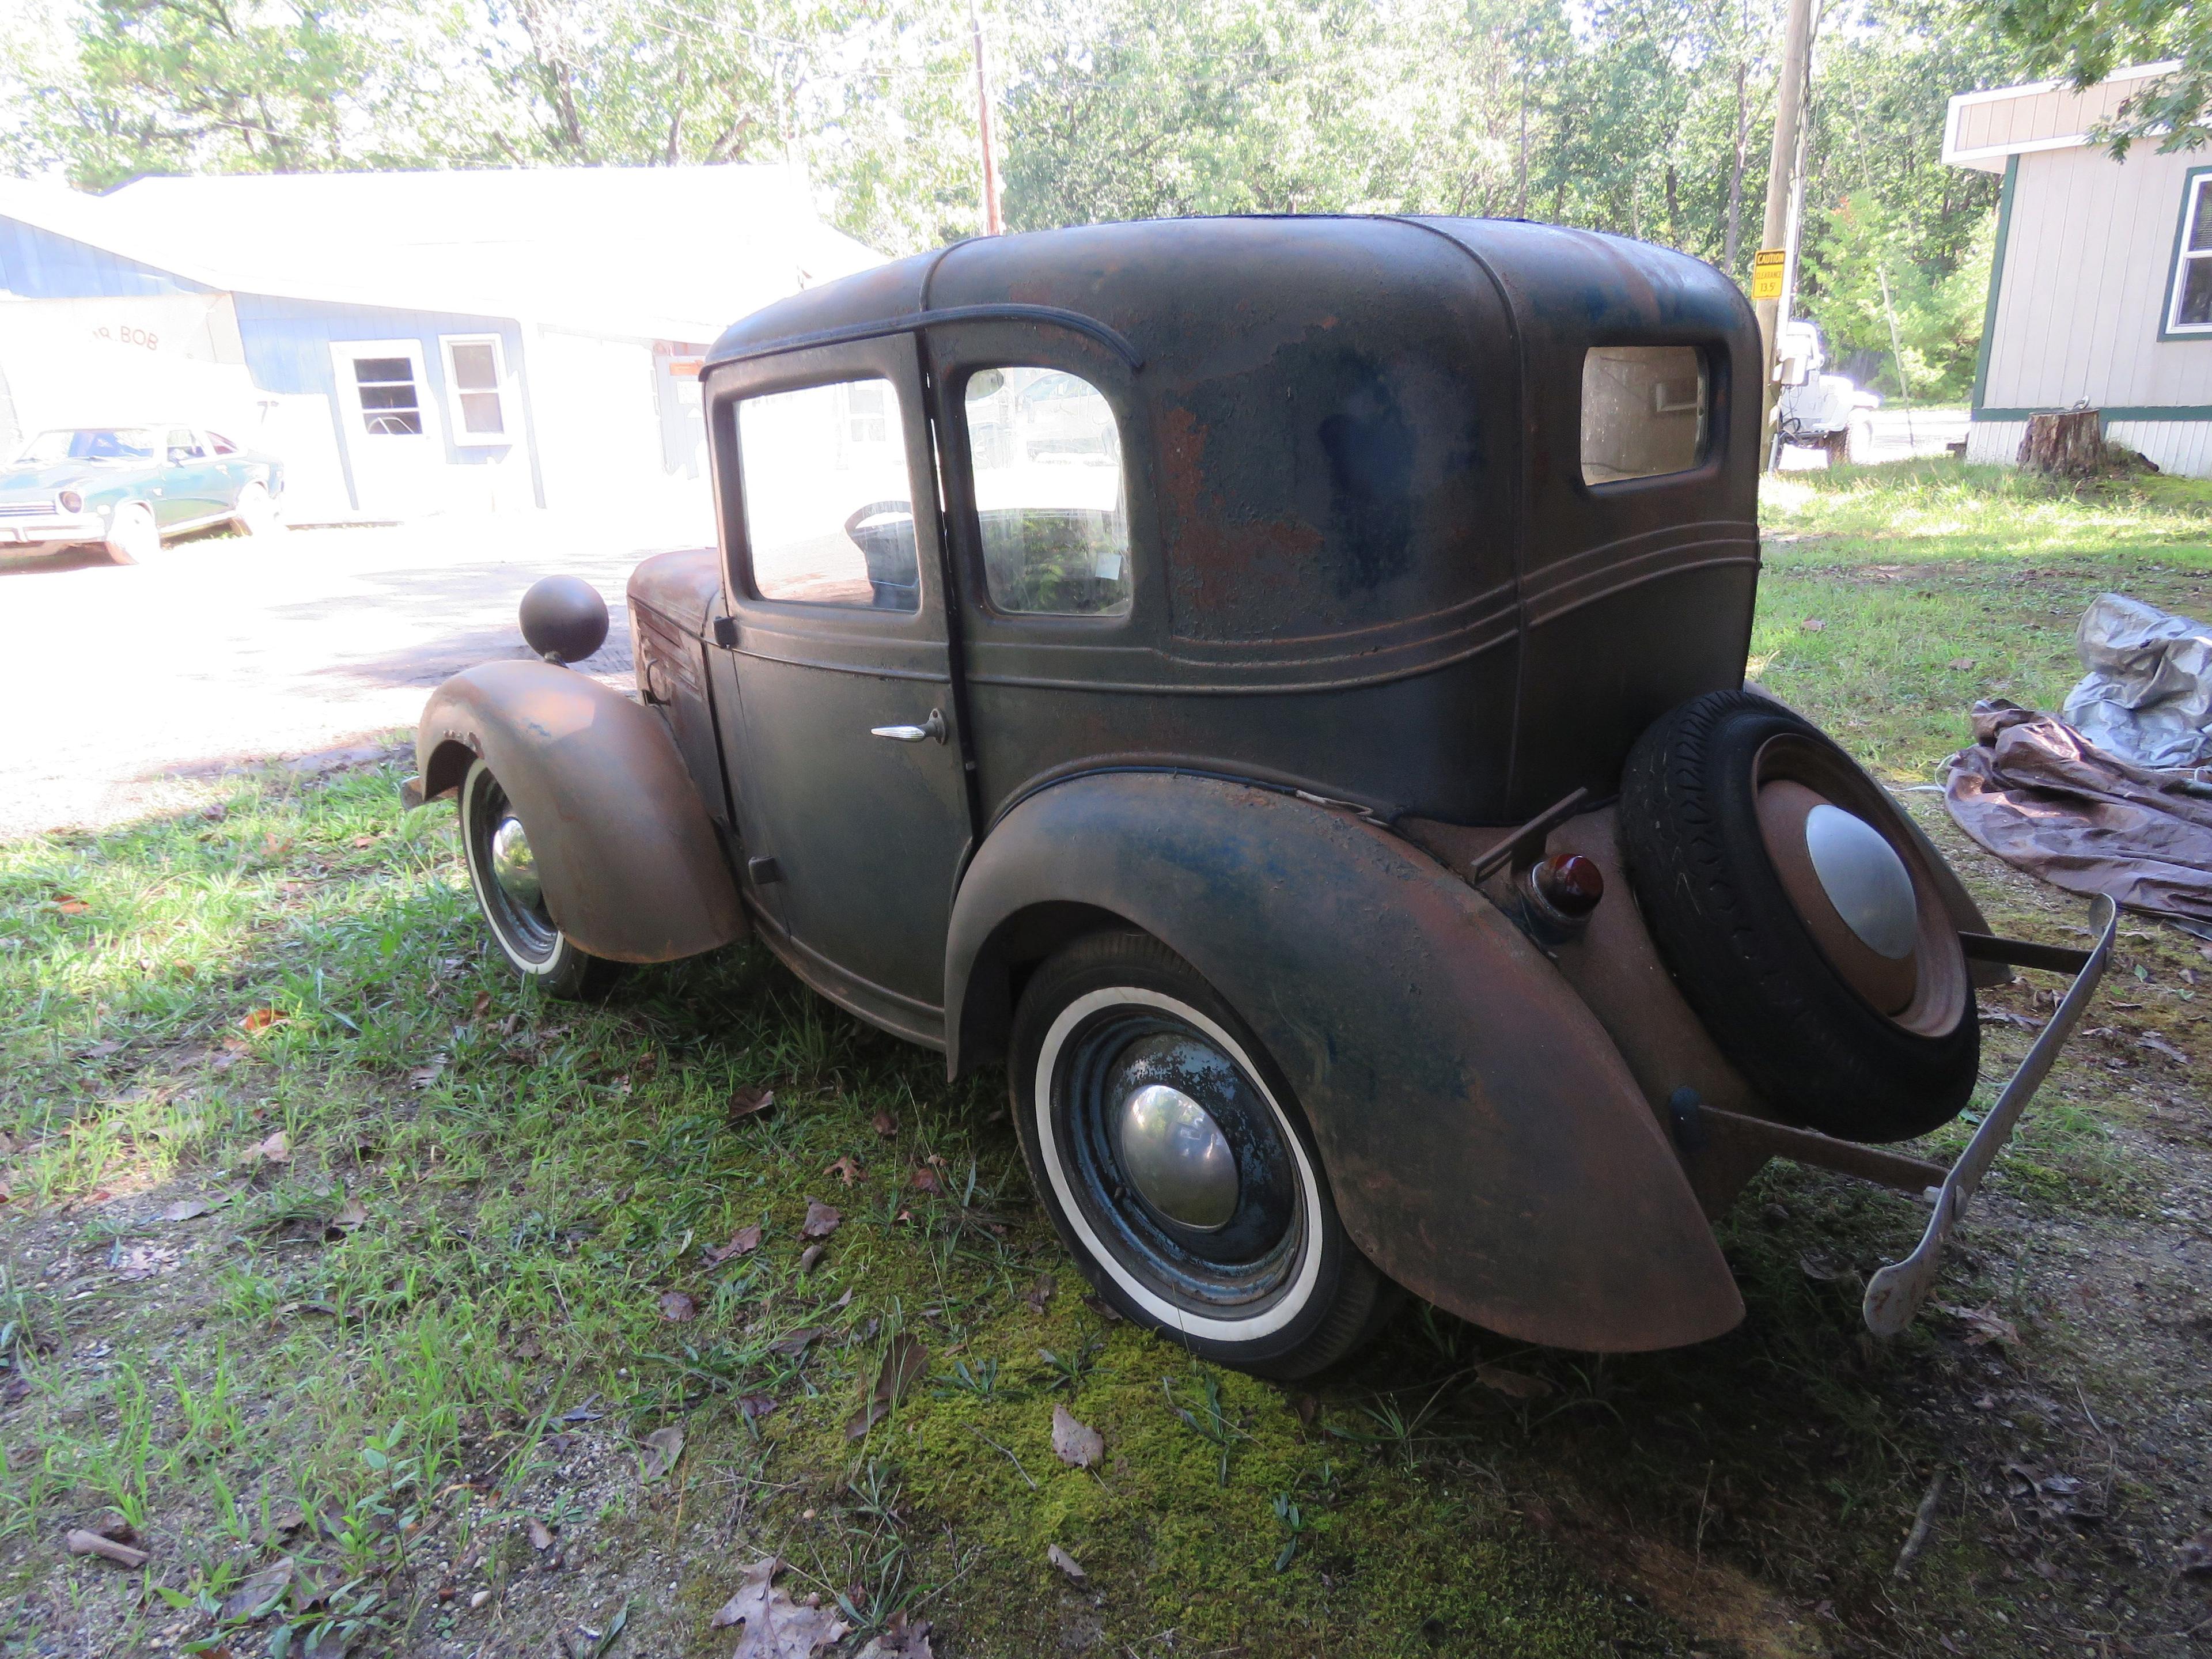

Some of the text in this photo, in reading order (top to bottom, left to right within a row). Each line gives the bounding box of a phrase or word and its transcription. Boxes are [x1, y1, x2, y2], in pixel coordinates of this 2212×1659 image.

[1758, 253, 1784, 264] CAUTION
[1756, 271, 1782, 280] CLEARANCE
[120, 325, 159, 351] BOB
